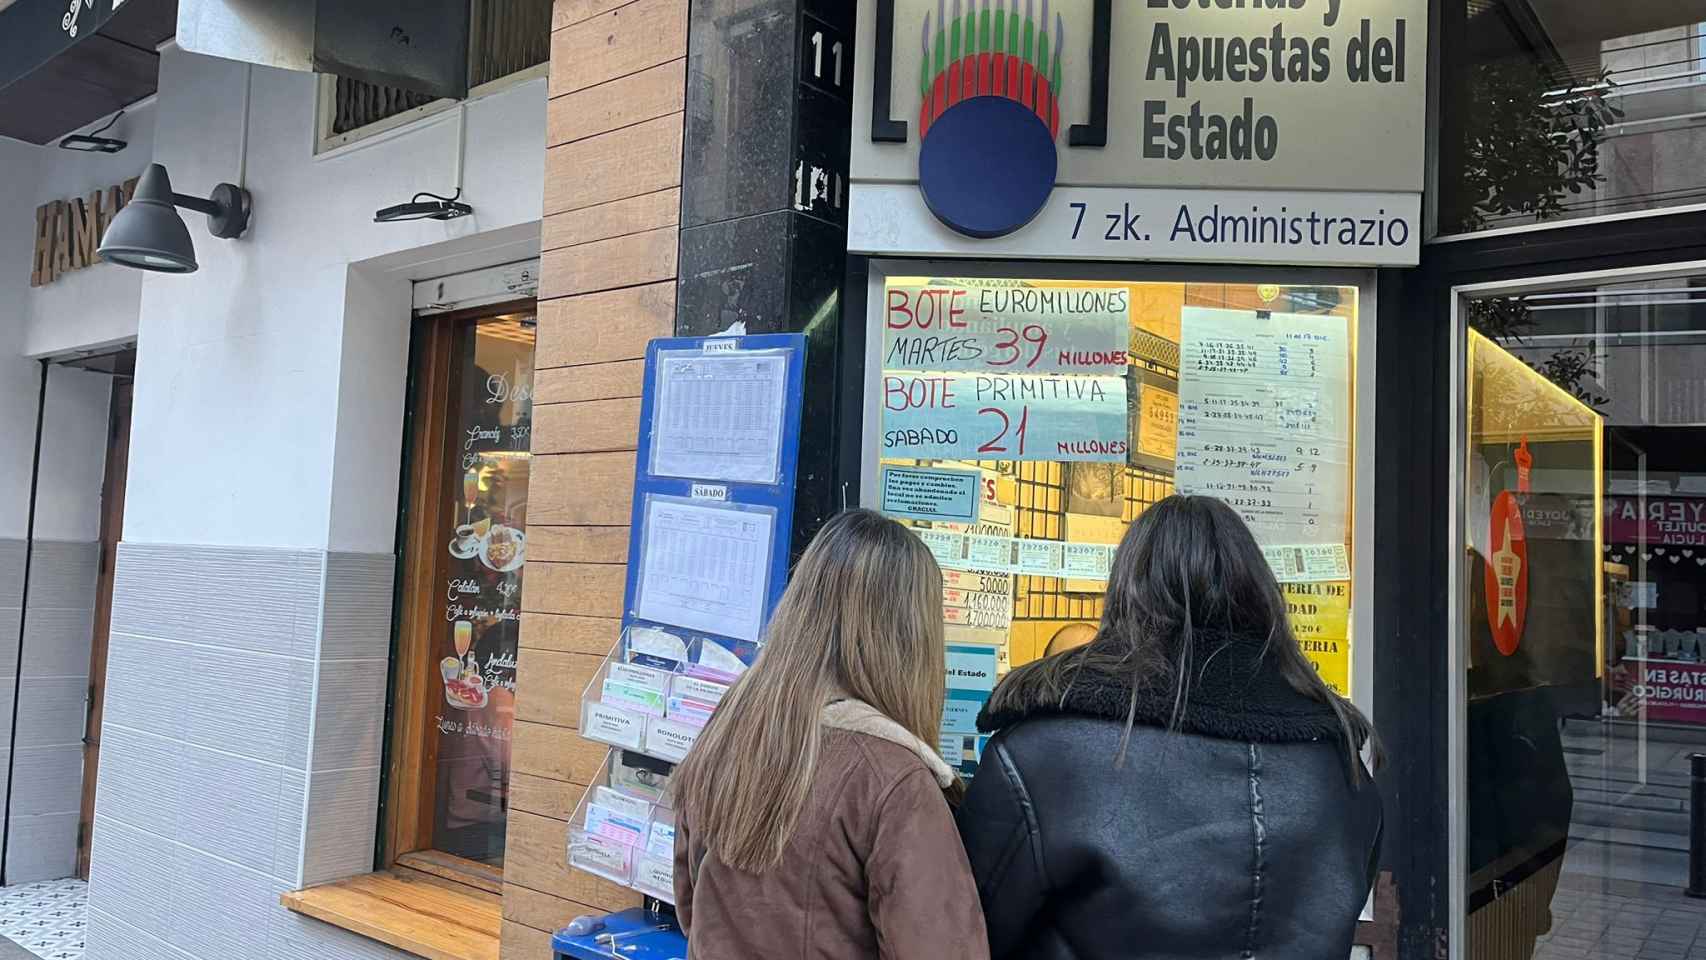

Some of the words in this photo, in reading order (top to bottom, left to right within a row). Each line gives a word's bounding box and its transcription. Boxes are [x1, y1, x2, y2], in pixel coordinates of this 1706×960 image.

[1145, 22, 1331, 98] Apuestas
[1346, 19, 1406, 83] del
[1143, 97, 1278, 161] Estado
[1069, 203, 1087, 240] 7
[1104, 203, 1150, 241] zk.
[1169, 204, 1409, 246] Administrazio
[888, 290, 967, 329] BOTE
[980, 289, 1126, 314] EUROMILLONES
[887, 336, 983, 365] MARTES
[986, 325, 1047, 368] 39
[1058, 351, 1127, 365] MILLONES
[885, 376, 956, 411] BOTE
[976, 377, 1106, 402] PRIMITIVA
[885, 428, 958, 448] SABADO
[977, 405, 1027, 455] 21
[1057, 441, 1126, 454] MILLONES
[1288, 604, 1317, 615] DAD
[1326, 585, 1345, 596] DE
[958, 669, 986, 678] Estado
[595, 712, 631, 725] PRIMITIVA
